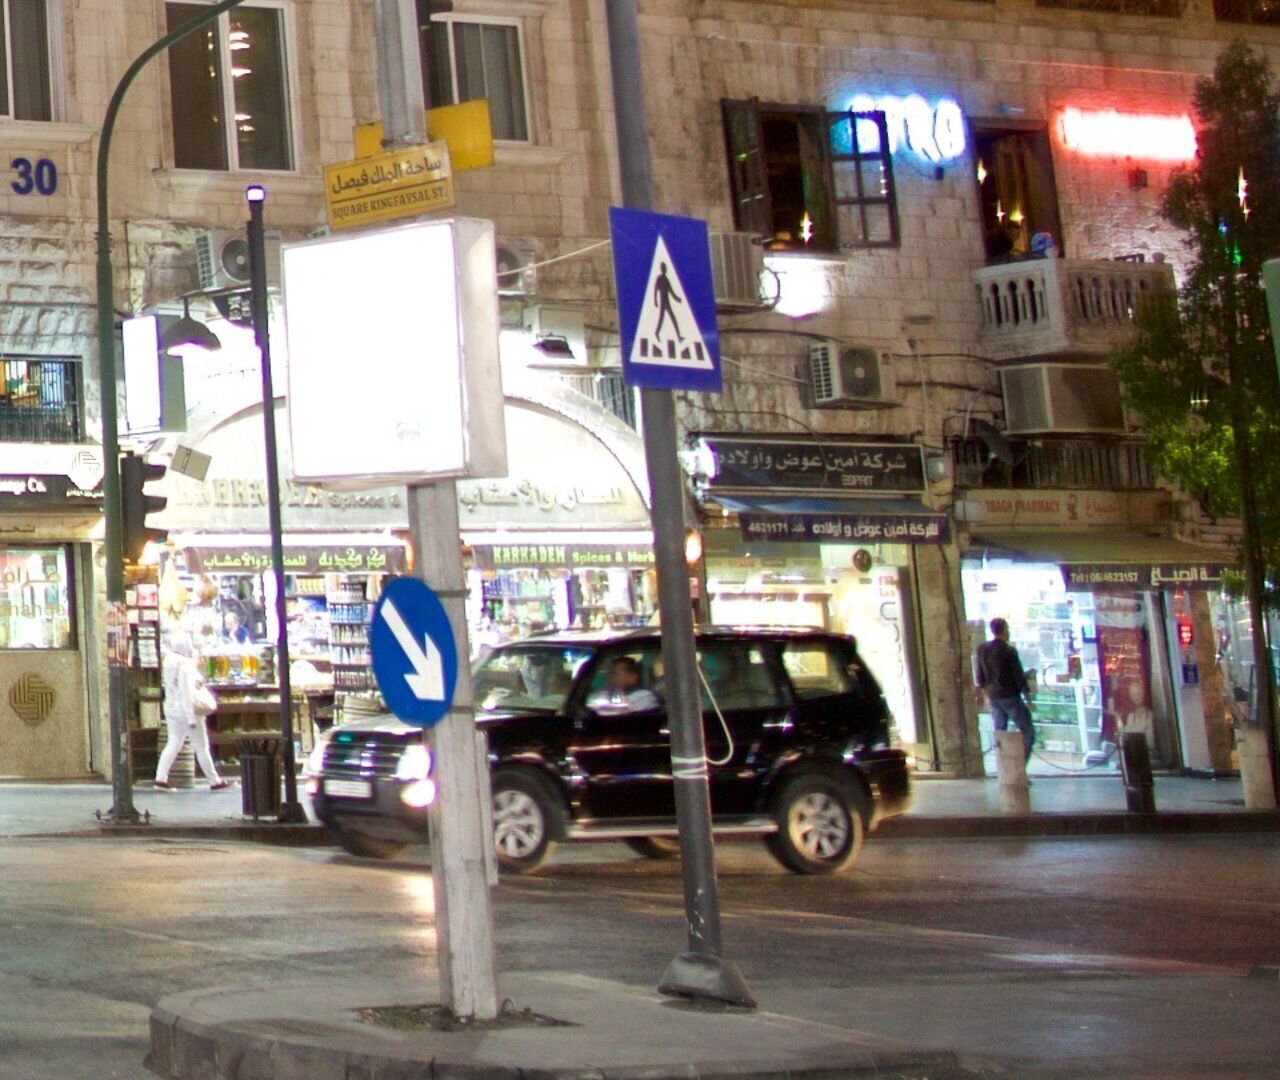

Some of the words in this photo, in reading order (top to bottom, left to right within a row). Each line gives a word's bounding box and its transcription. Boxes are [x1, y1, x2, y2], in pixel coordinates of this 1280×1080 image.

[9, 156, 59, 197] 30
[371, 163, 403, 185] الملك
[406, 157, 442, 176] ساحة
[332, 169, 369, 194] فيصل
[333, 201, 369, 220] SQUARE
[862, 451, 907, 473] شركة
[492, 546, 566, 563] KARKADEH
[571, 552, 612, 565] Spices
